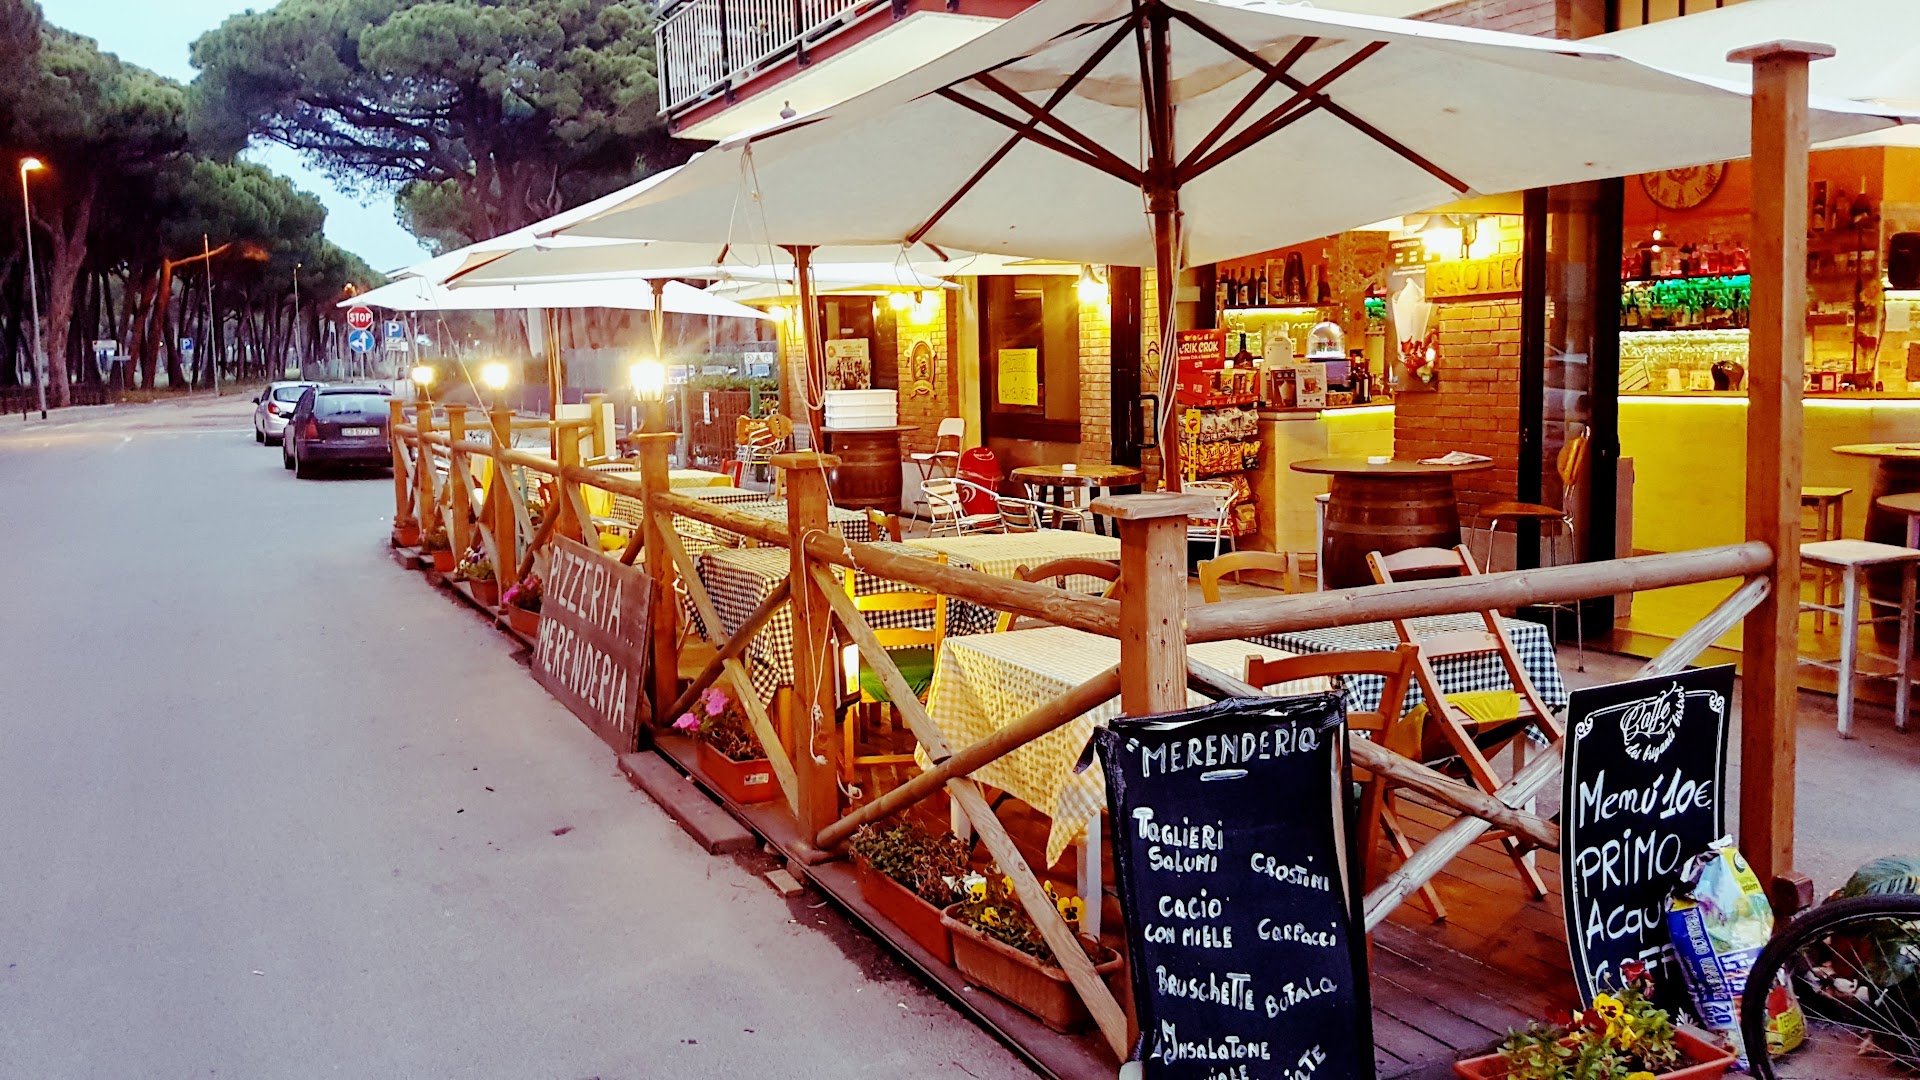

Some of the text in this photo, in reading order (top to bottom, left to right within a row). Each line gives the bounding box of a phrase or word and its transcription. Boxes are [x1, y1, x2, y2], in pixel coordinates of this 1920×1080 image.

[349, 312, 372, 323] STOP
[388, 322, 400, 337] P
[182, 339, 191, 349] P
[547, 545, 622, 637] PIZZERIA
[535, 617, 627, 733] MERENDERIA
[1144, 923, 1175, 944] CON
[1712, 1004, 1732, 1024] 20
